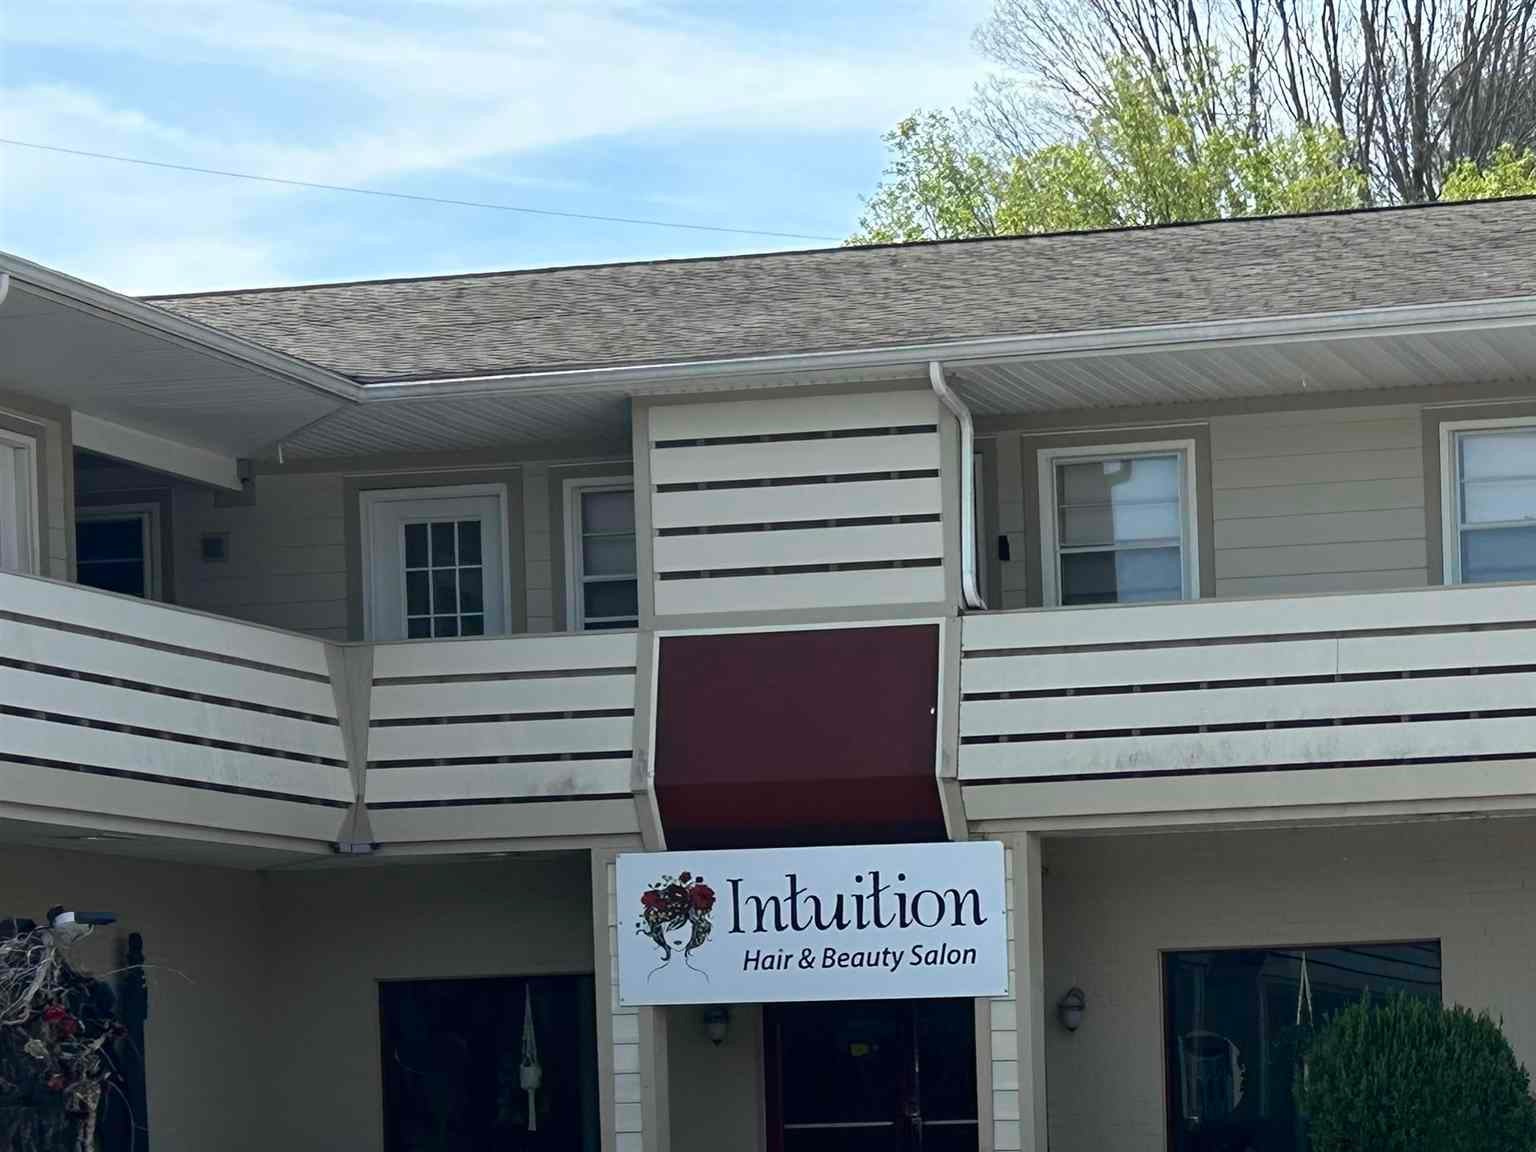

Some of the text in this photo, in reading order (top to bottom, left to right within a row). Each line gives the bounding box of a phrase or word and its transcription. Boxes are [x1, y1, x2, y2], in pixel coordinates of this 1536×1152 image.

[725, 870, 989, 935] Intuition
[743, 942, 978, 973] Hair & Beauty Salon
